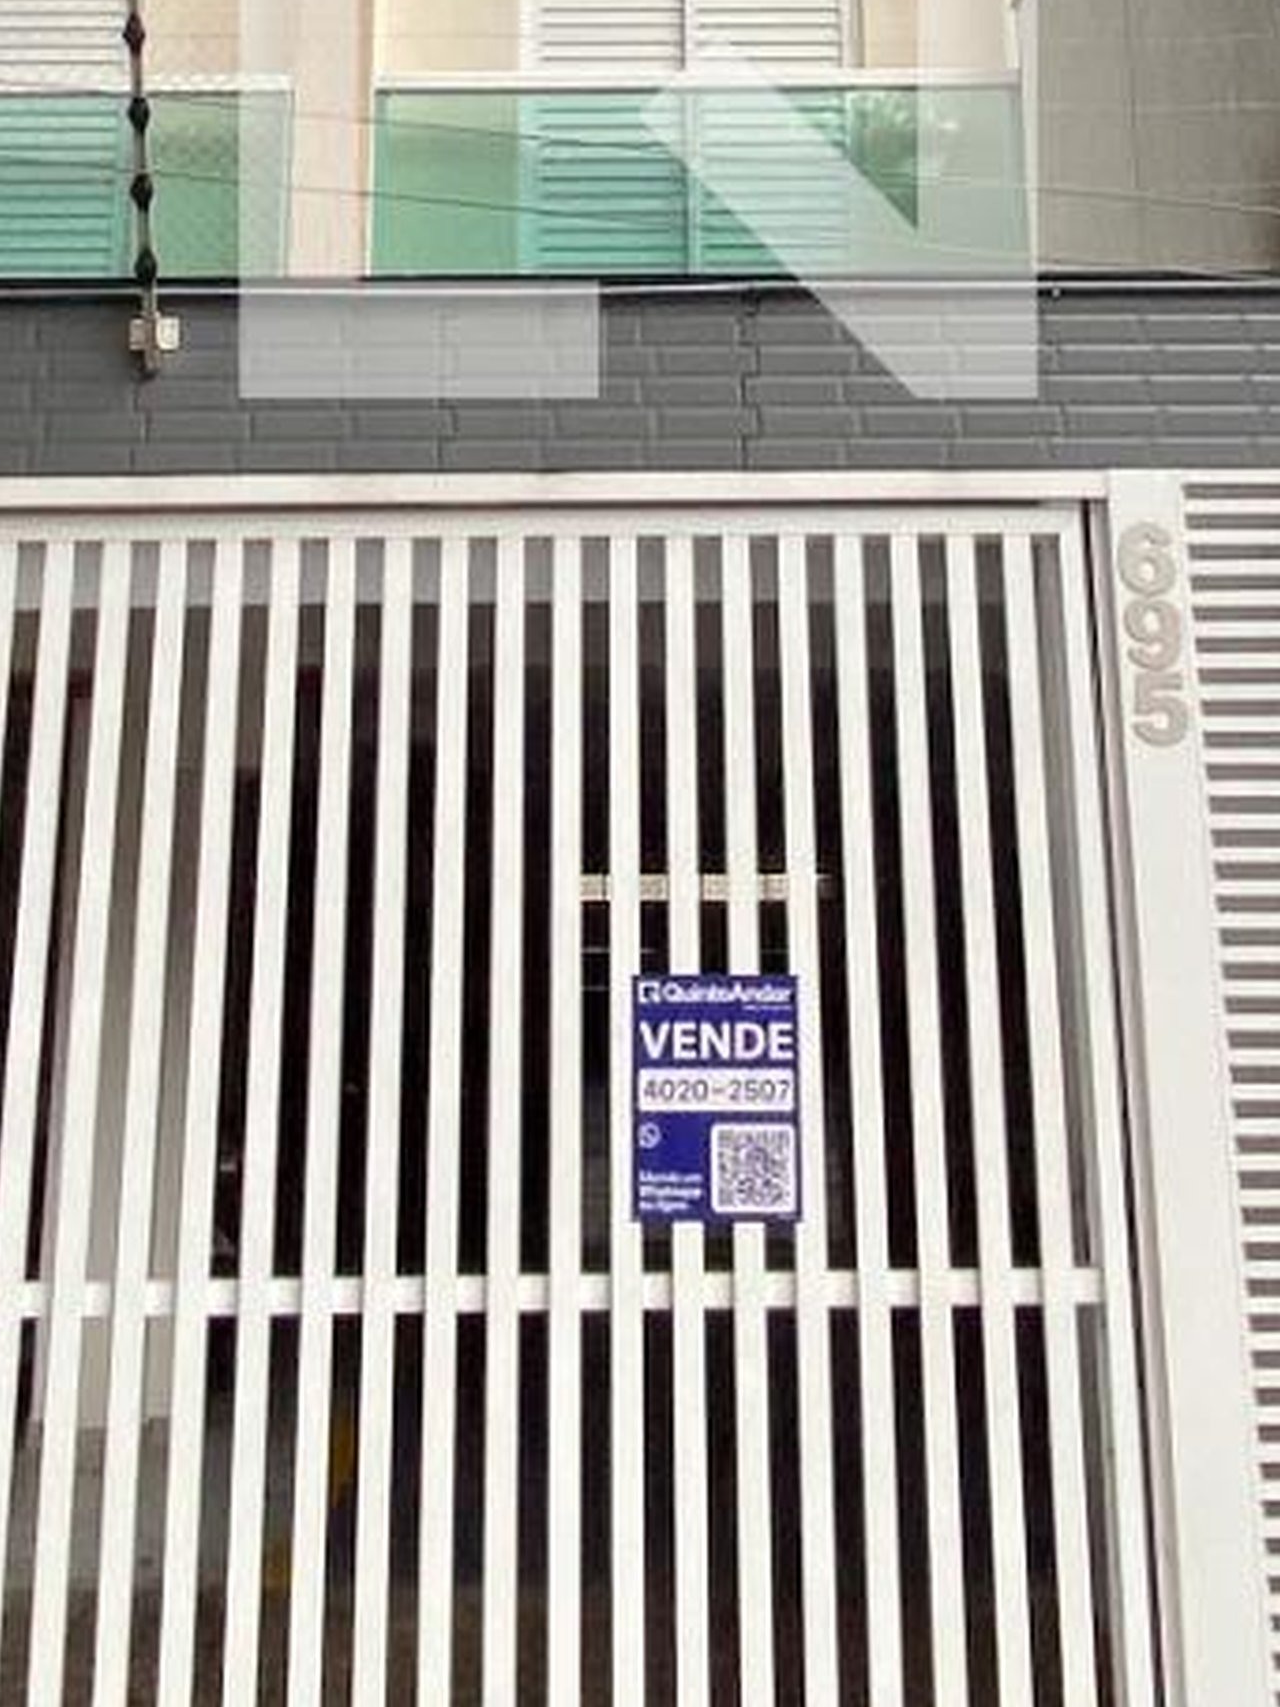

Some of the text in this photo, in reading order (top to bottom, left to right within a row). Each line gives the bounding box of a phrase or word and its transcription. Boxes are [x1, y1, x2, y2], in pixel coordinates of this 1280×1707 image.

[1116, 519, 1189, 748] 695
[661, 981, 793, 1003] QuintoAndar
[638, 1020, 795, 1060] VENDE
[642, 1079, 791, 1104] 4020-2507
